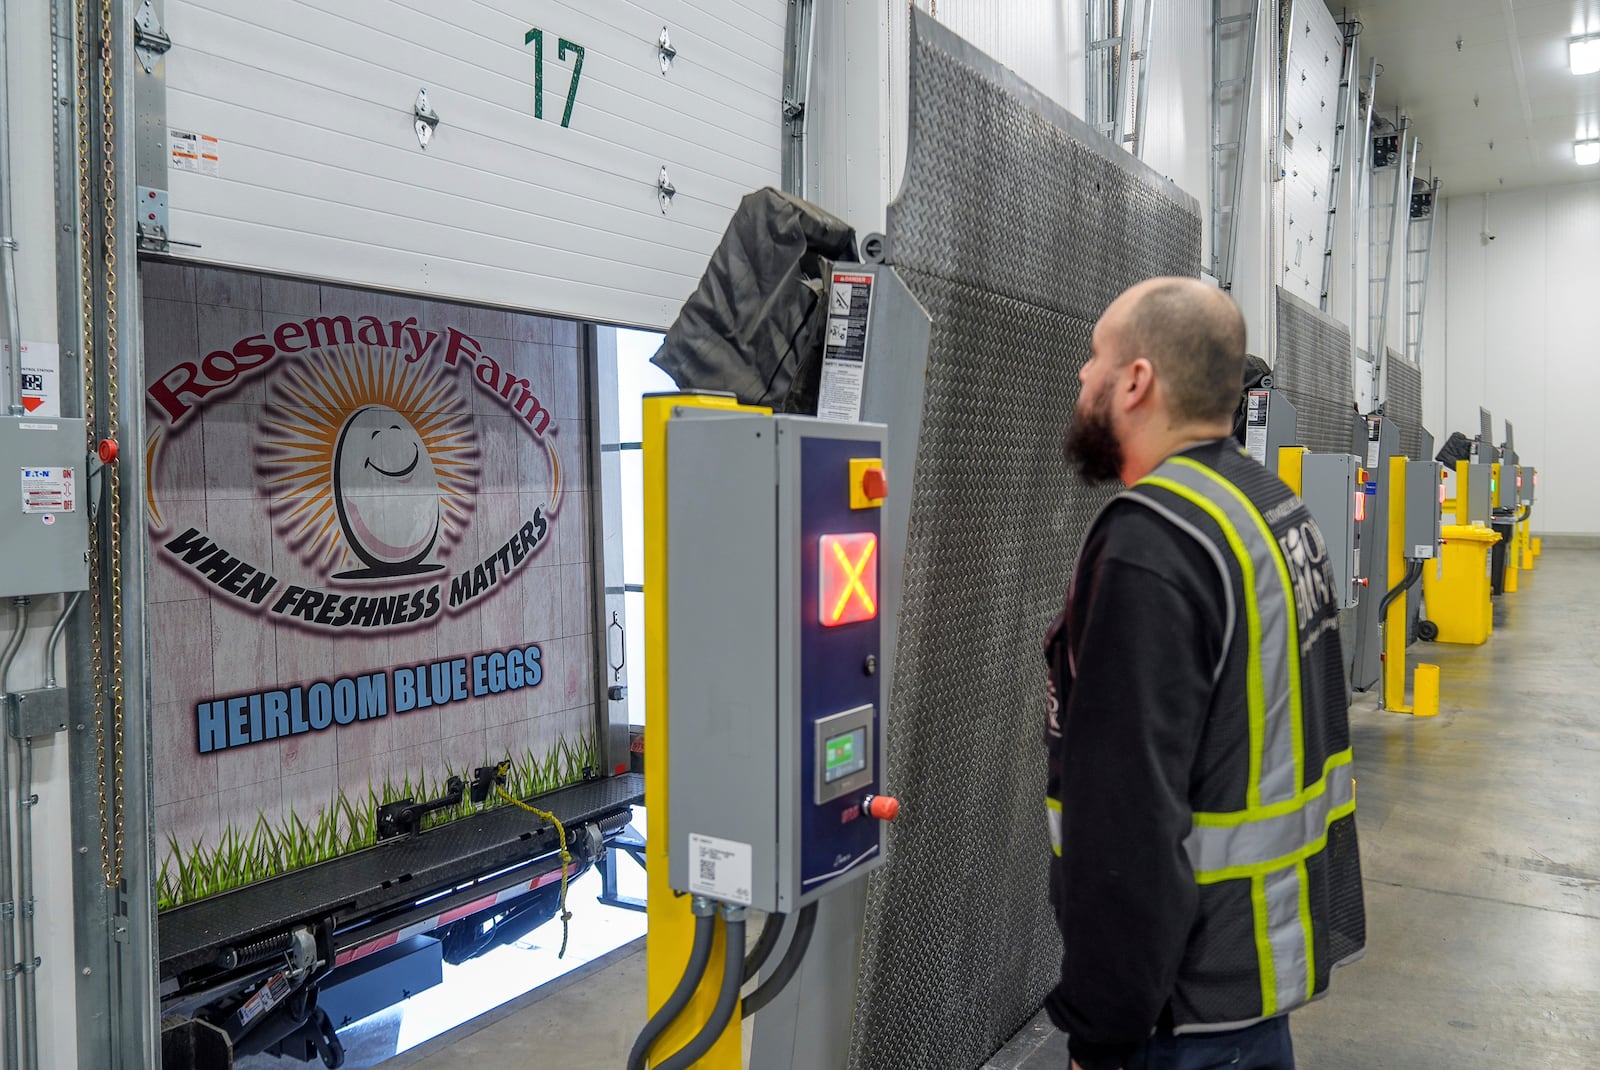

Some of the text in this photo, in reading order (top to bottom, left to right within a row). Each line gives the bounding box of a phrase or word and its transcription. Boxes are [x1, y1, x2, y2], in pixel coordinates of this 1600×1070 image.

[525, 27, 585, 129] 17
[147, 315, 550, 437] Rosemary Farm
[164, 506, 547, 627] WHEN FRESHNESS MATTERS
[198, 646, 543, 754] HEIRLOOM BLUE EGGS
